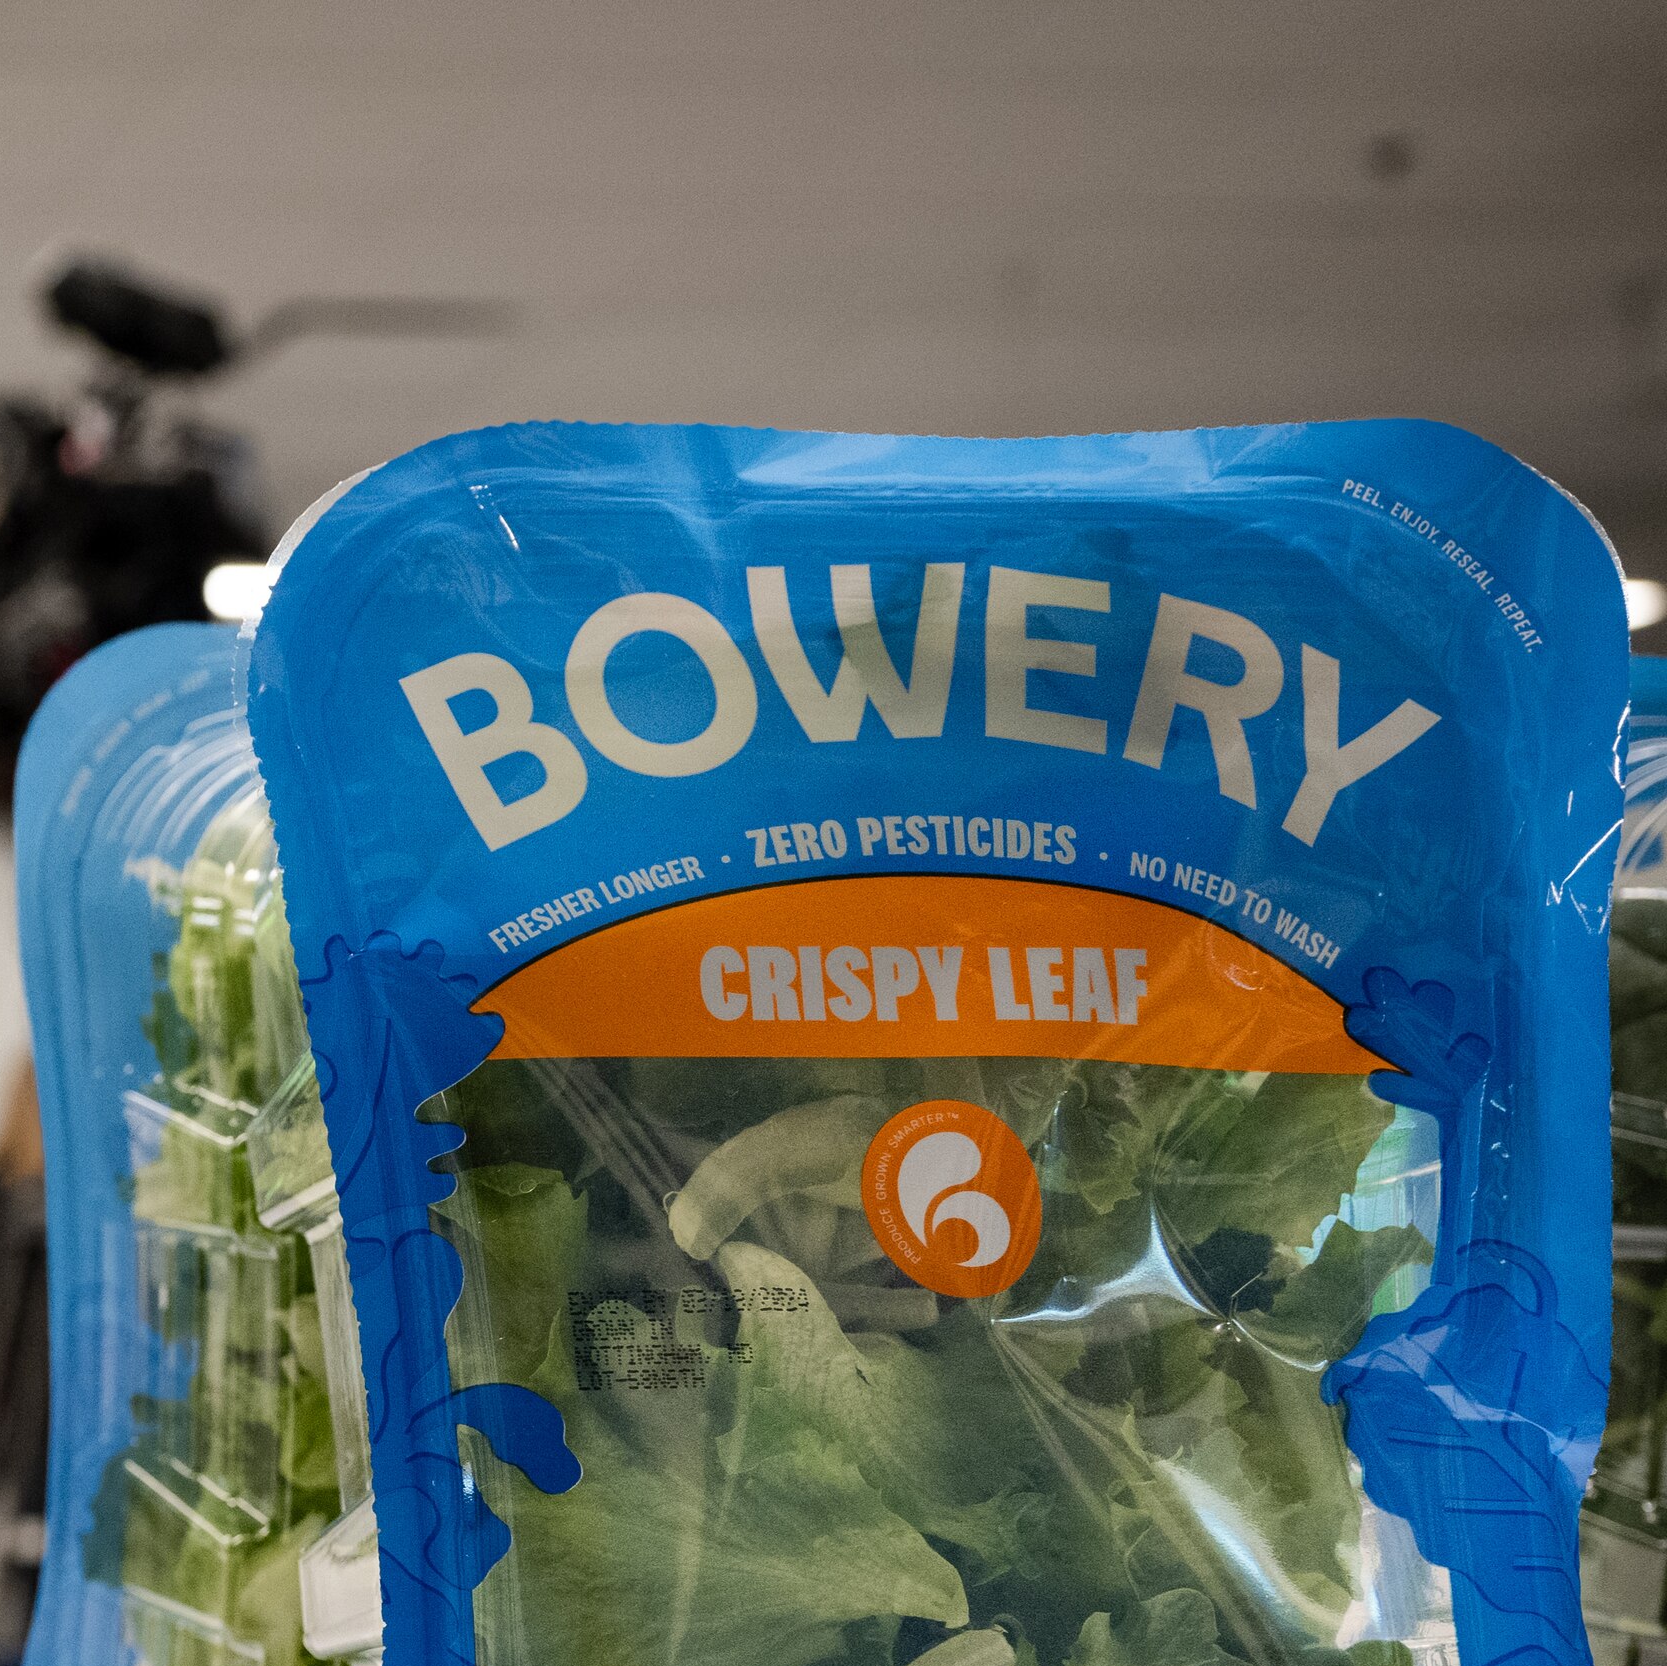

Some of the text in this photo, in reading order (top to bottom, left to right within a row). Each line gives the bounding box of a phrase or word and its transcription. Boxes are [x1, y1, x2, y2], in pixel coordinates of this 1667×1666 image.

[1341, 479, 1542, 653] PEEL. ENJOY. RESEAL. REPEAT.
[398, 560, 1442, 851] BOWERY
[487, 815, 1342, 970] FRESHER LONGER ZERO PESTICIDES NO NEED TO WASH
[700, 945, 1147, 1026] CRISPY LEAF
[875, 1152, 892, 1200] GROWN
[879, 1208, 922, 1265] PRODUCE
[567, 1290, 629, 1315] ENJOY
[641, 1288, 666, 1314] BY
[573, 1318, 674, 1341] GROWN IN
[727, 1343, 754, 1364] MD
